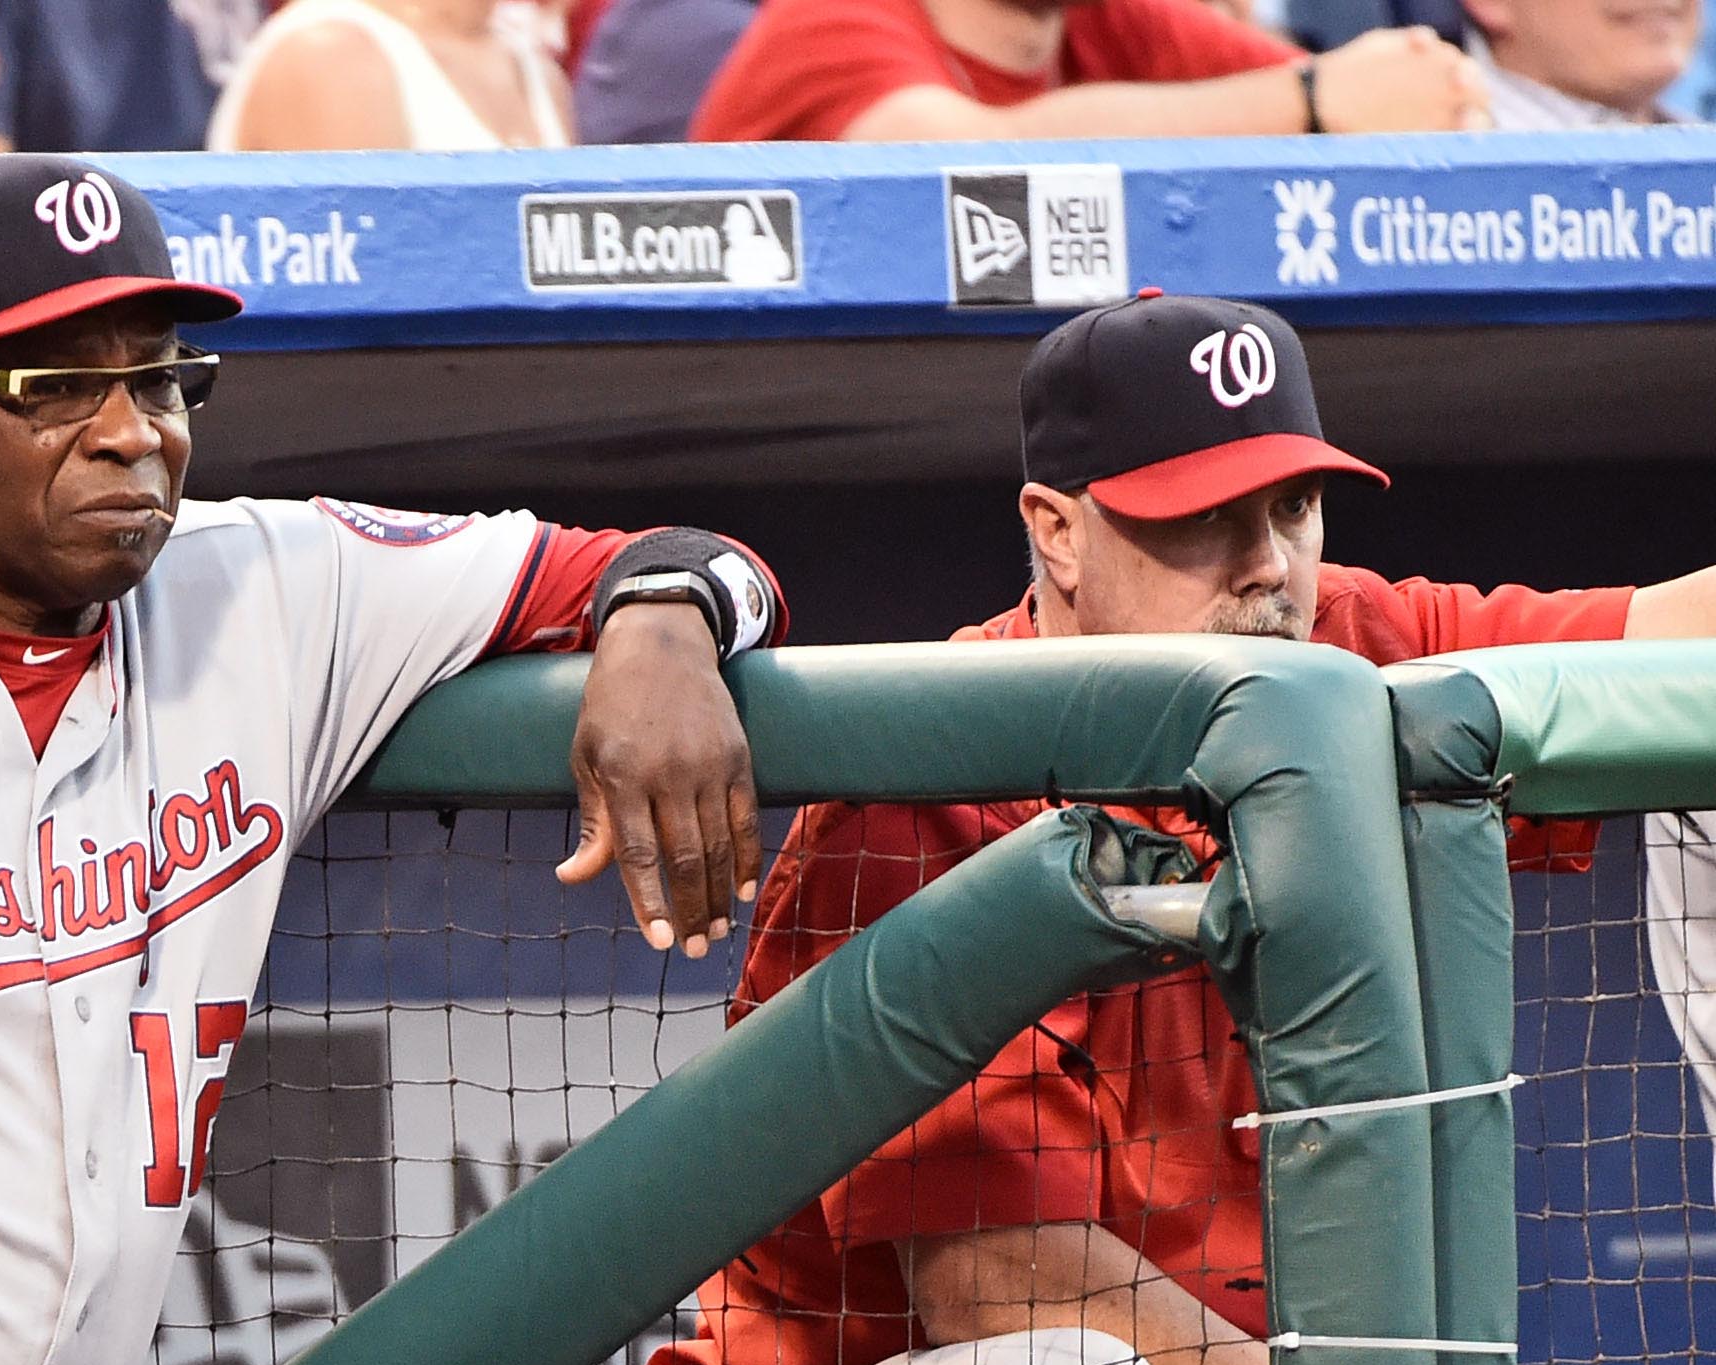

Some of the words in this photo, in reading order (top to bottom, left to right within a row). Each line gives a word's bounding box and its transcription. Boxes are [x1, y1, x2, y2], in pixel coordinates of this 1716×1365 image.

[530, 212, 721, 276] MLB.com
[1046, 195, 1110, 234] NEW
[1350, 195, 1527, 266] Citizens
[1530, 187, 1642, 262] Bank
[1647, 185, 1716, 259] Par
[168, 213, 252, 286] ank
[1048, 238, 1112, 277] ERA
